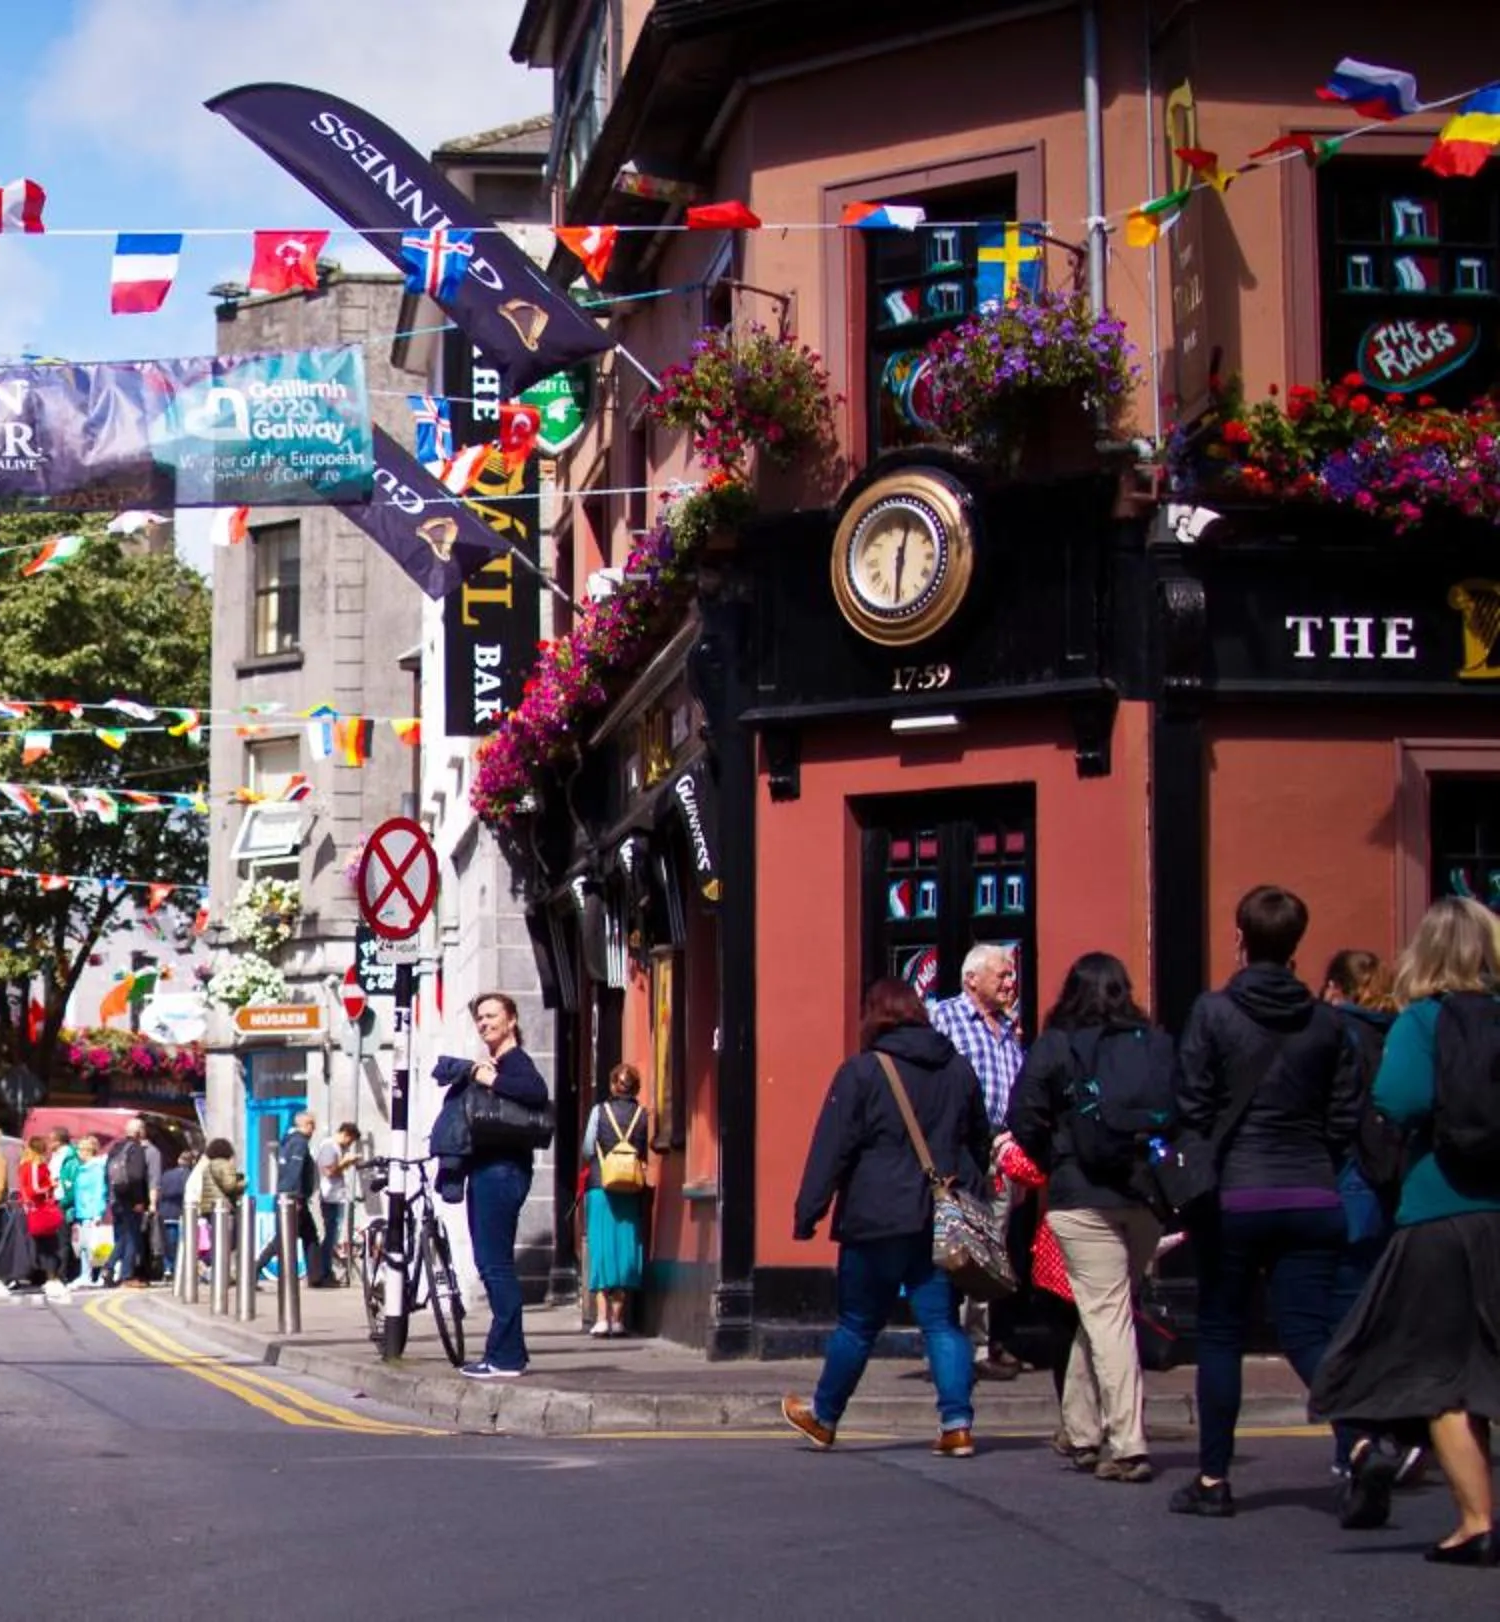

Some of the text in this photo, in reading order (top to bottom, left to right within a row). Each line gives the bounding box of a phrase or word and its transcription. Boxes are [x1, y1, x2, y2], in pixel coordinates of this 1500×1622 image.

[310, 110, 505, 291] GINNESS
[1374, 319, 1423, 352] THE
[1375, 322, 1456, 379] RACES
[471, 345, 502, 421] HE
[252, 417, 346, 444] Galway
[240, 451, 258, 467] of
[290, 451, 366, 468] European
[1285, 616, 1417, 659] THE
[473, 643, 503, 724] BAR
